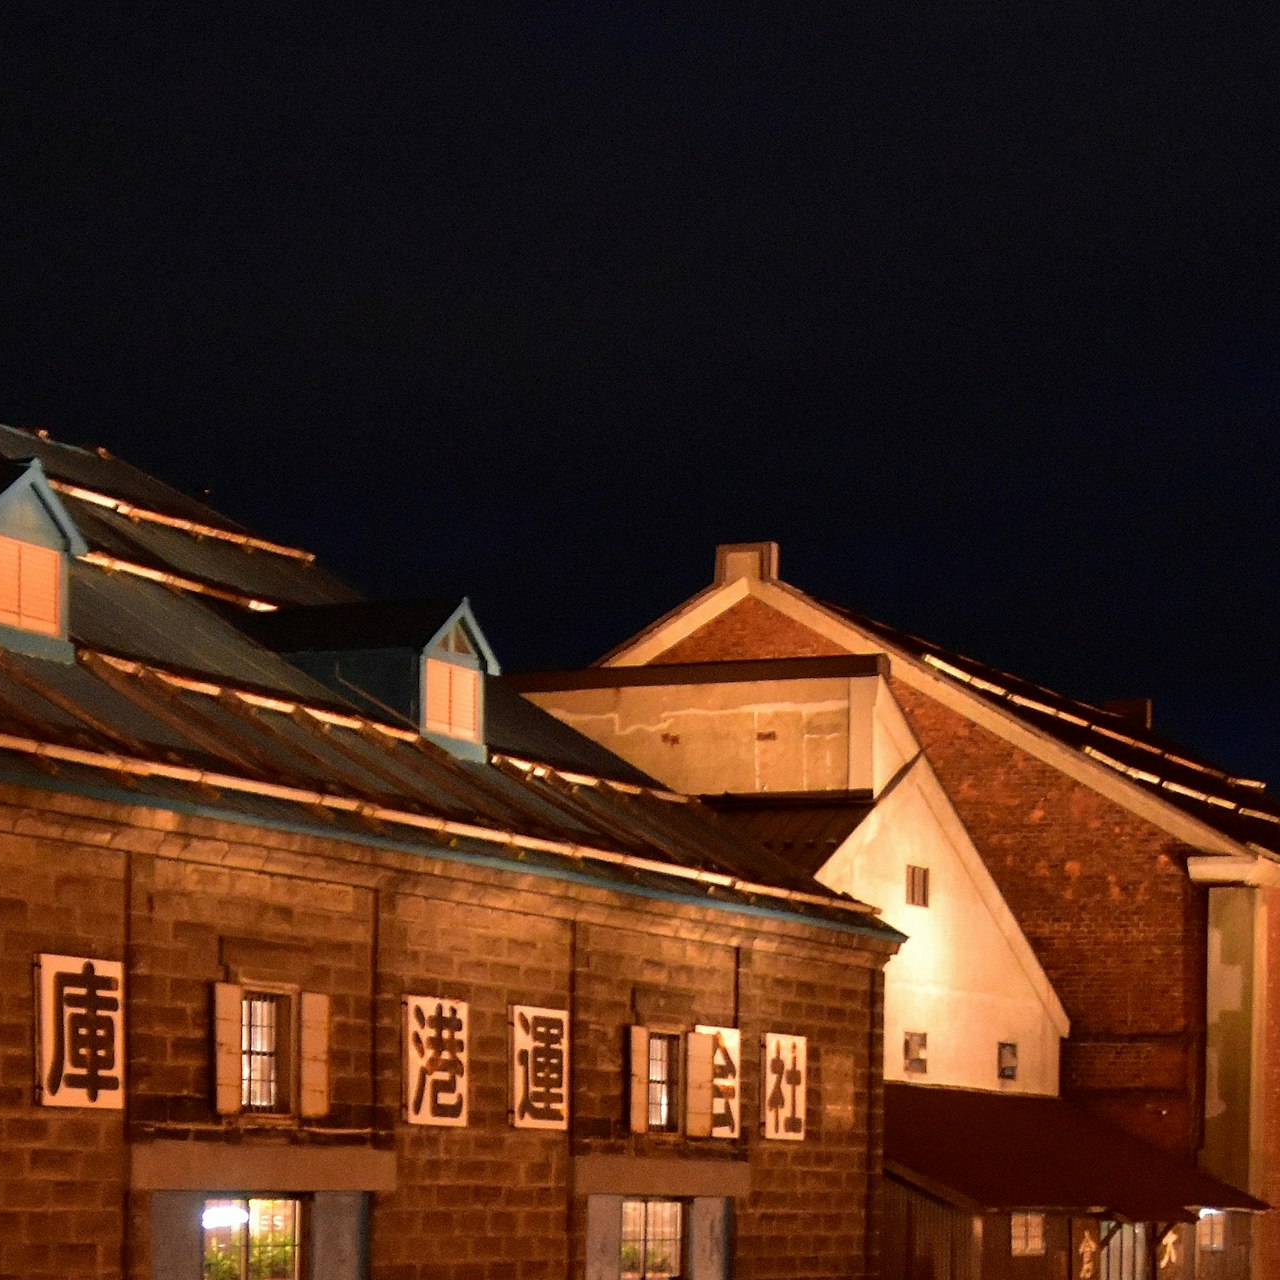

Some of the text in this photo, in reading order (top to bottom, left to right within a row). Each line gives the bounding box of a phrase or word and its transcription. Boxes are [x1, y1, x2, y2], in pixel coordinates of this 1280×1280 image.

[47, 961, 120, 1102] 庫
[412, 1003, 464, 1118] 港
[517, 1011, 565, 1121] 運
[767, 1040, 802, 1134] 社
